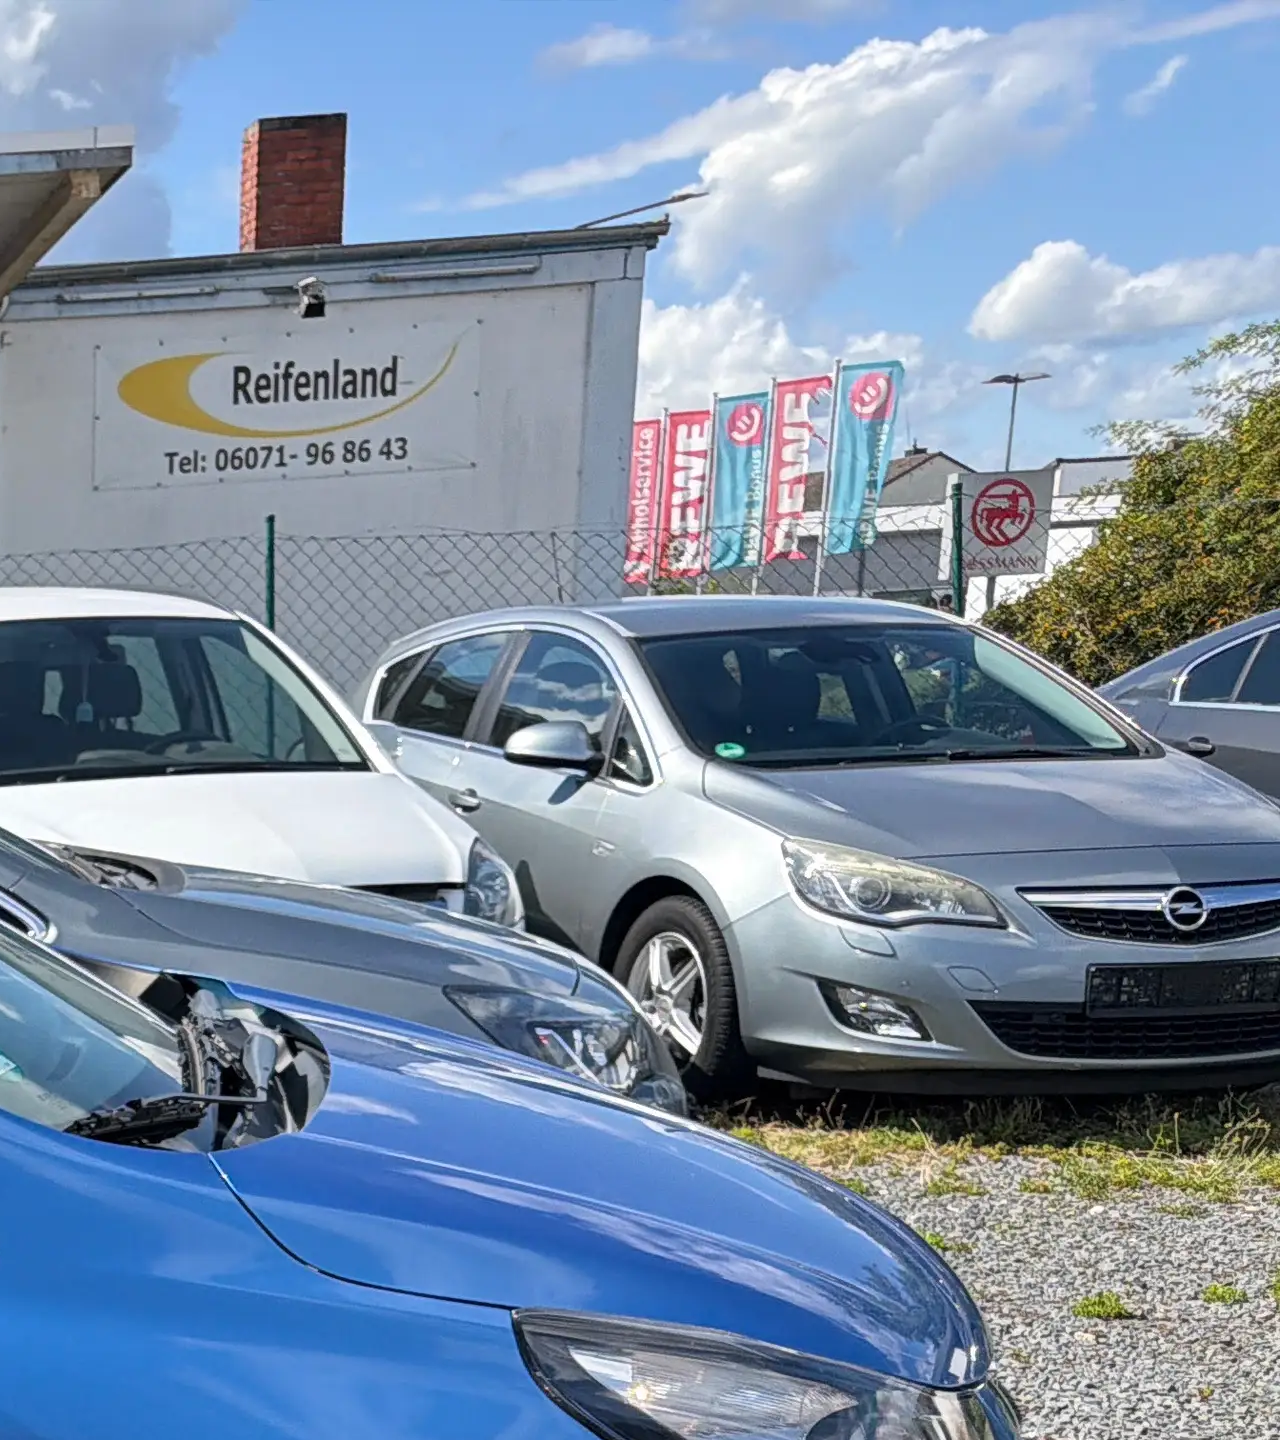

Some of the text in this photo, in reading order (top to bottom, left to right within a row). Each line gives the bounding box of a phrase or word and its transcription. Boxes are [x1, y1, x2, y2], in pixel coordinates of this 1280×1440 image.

[232, 354, 398, 405] Reifenland
[164, 436, 409, 475] Tel: 06071- 96 86 43
